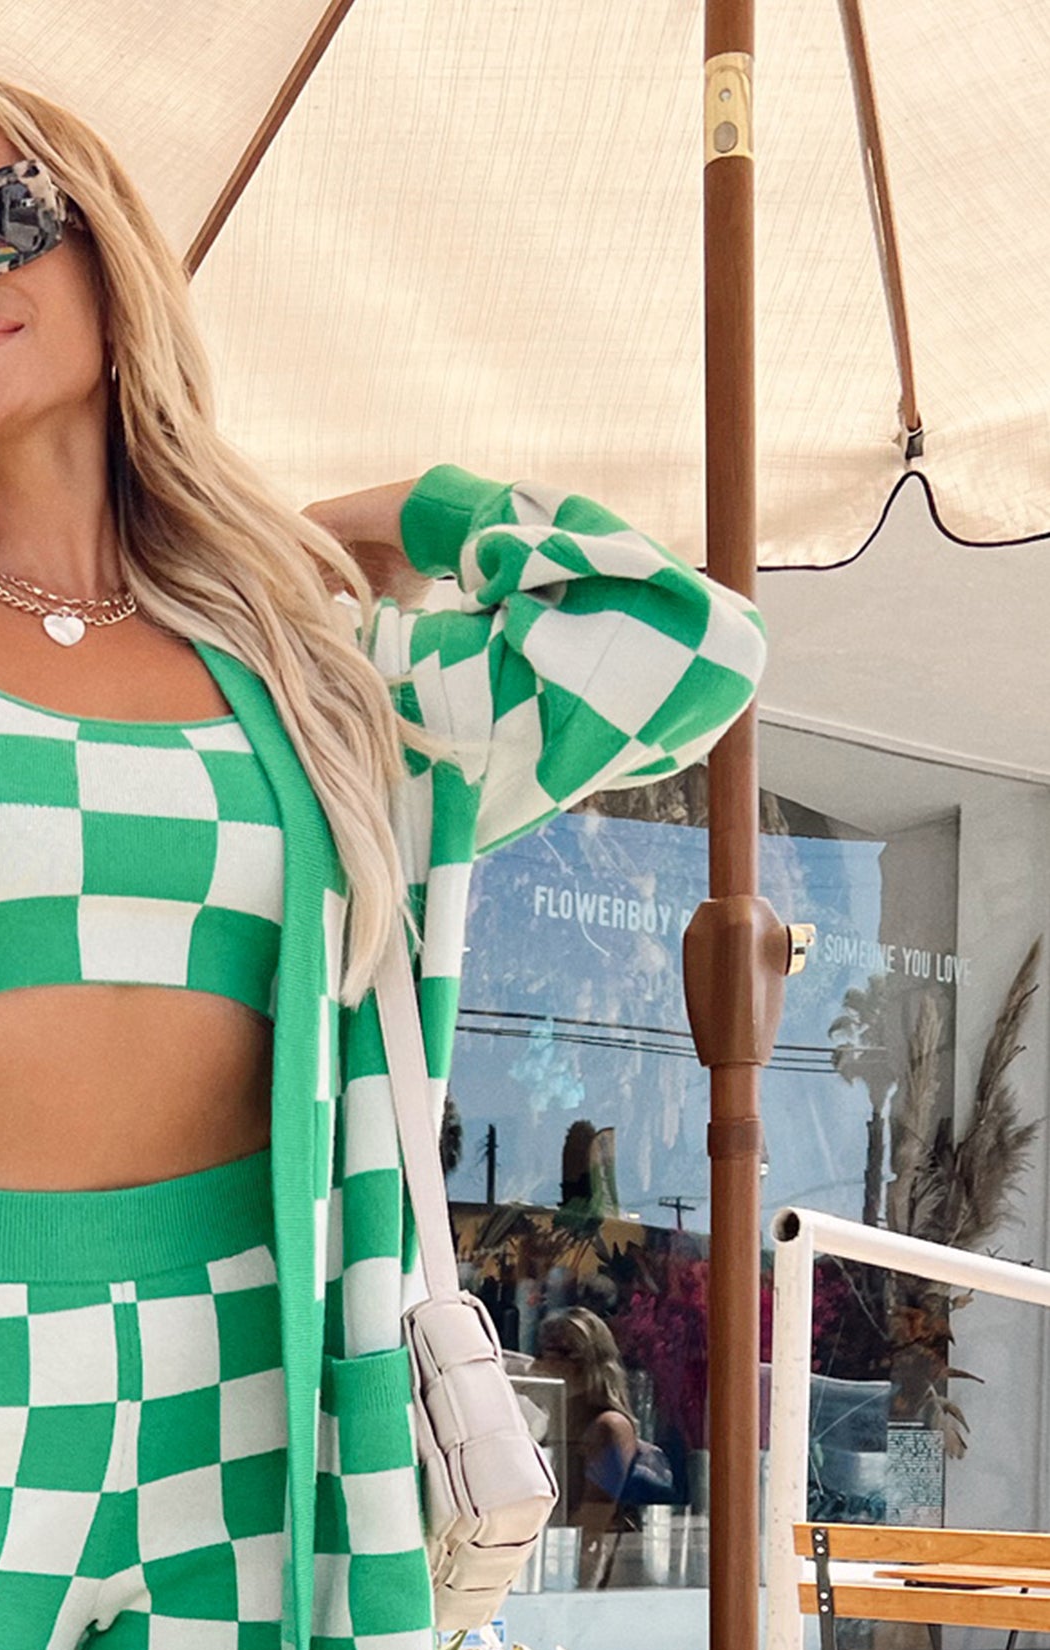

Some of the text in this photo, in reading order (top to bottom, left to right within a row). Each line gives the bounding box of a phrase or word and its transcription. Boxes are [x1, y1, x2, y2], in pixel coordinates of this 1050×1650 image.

[534, 885, 672, 936] FLOWERBOY
[824, 933, 897, 974] SOMEONE
[902, 946, 931, 979] YOU
[936, 953, 973, 986] LOVE
